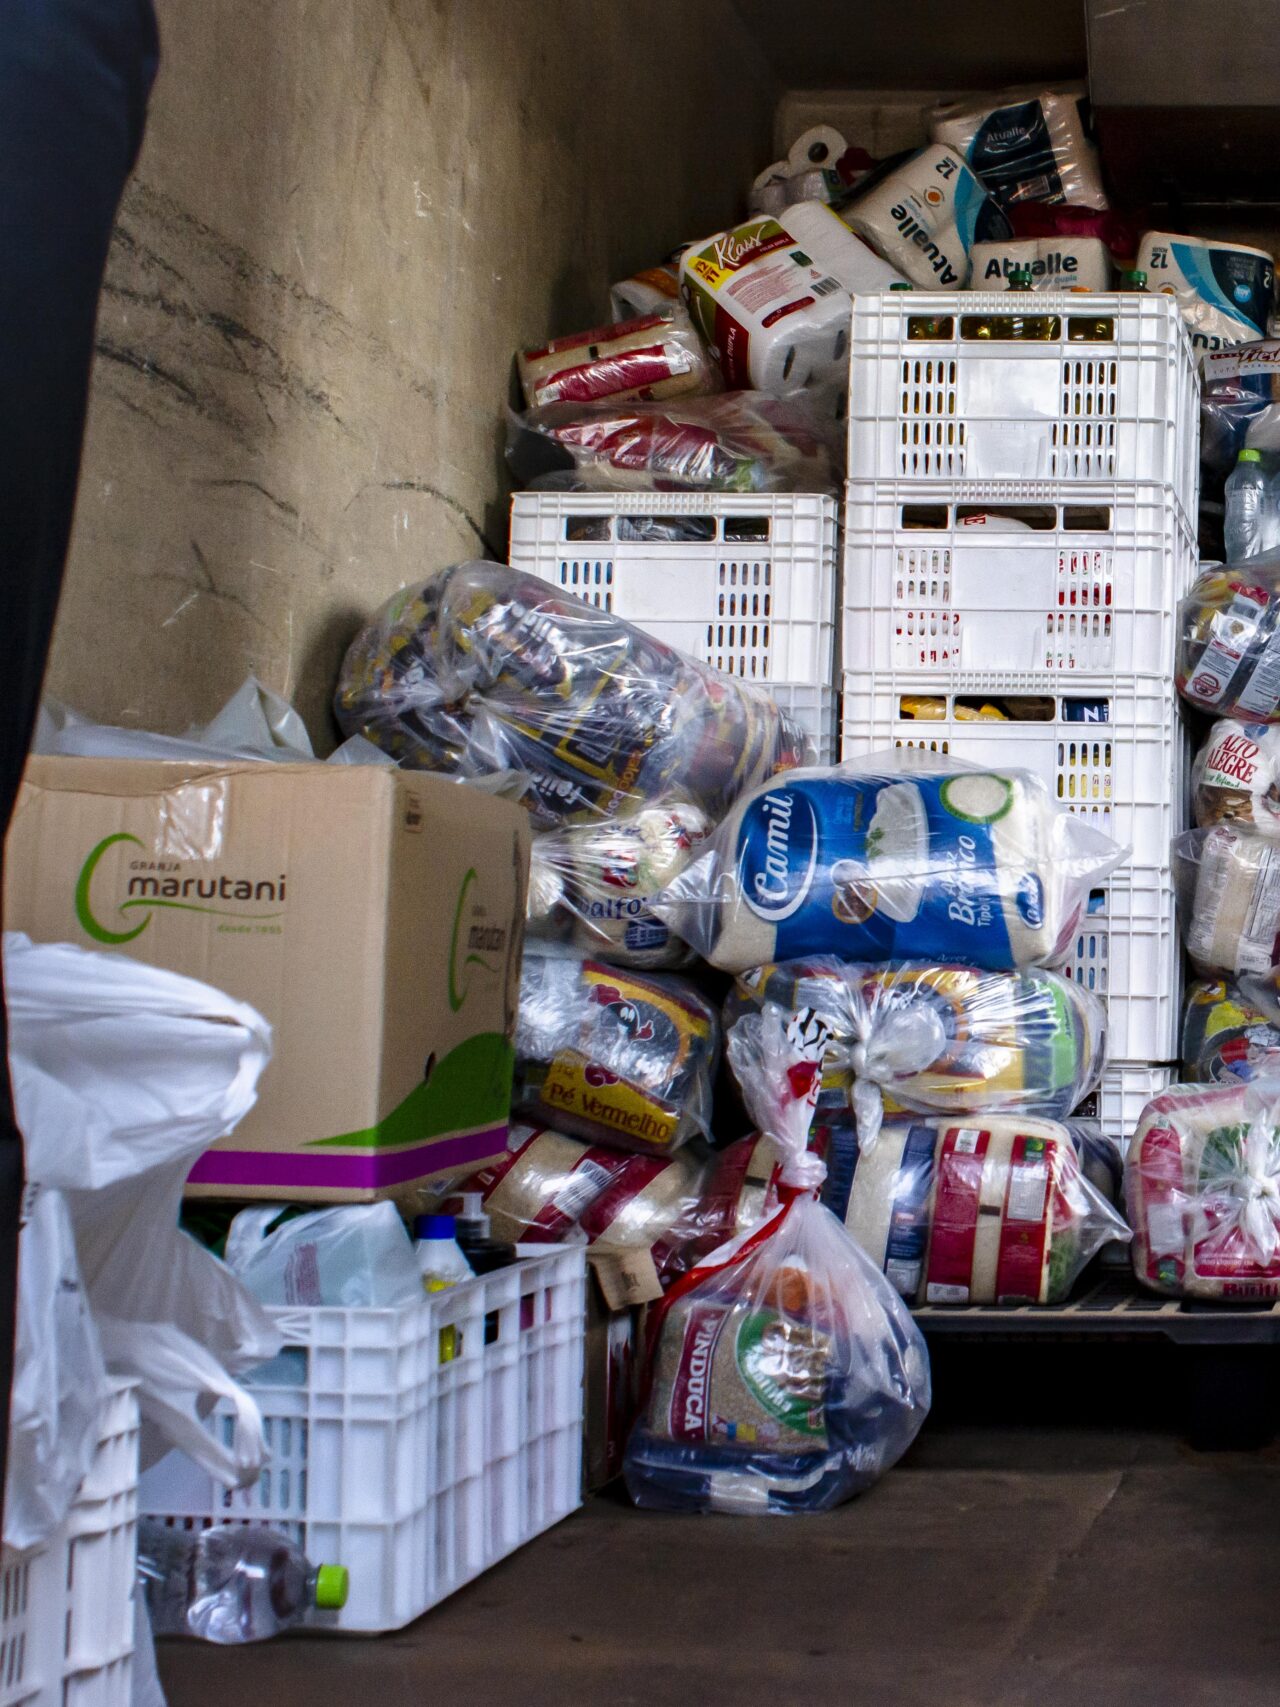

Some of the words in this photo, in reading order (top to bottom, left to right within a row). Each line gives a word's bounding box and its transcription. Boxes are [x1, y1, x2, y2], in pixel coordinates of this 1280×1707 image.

[986, 126, 1027, 143] Atualle
[935, 158, 955, 180] 12
[891, 204, 959, 286] Atualle
[985, 252, 1078, 279] Atualle
[1151, 253, 1168, 269] 12
[1217, 733, 1261, 760] ALTO
[1204, 751, 1257, 785] ALEGRE
[755, 791, 795, 902] Camil
[130, 860, 182, 872] GRANJA
[128, 874, 287, 902] marutani
[551, 1082, 576, 1106] Pé
[580, 1090, 670, 1141] Vermelho
[684, 1314, 718, 1432] PINDUCA
